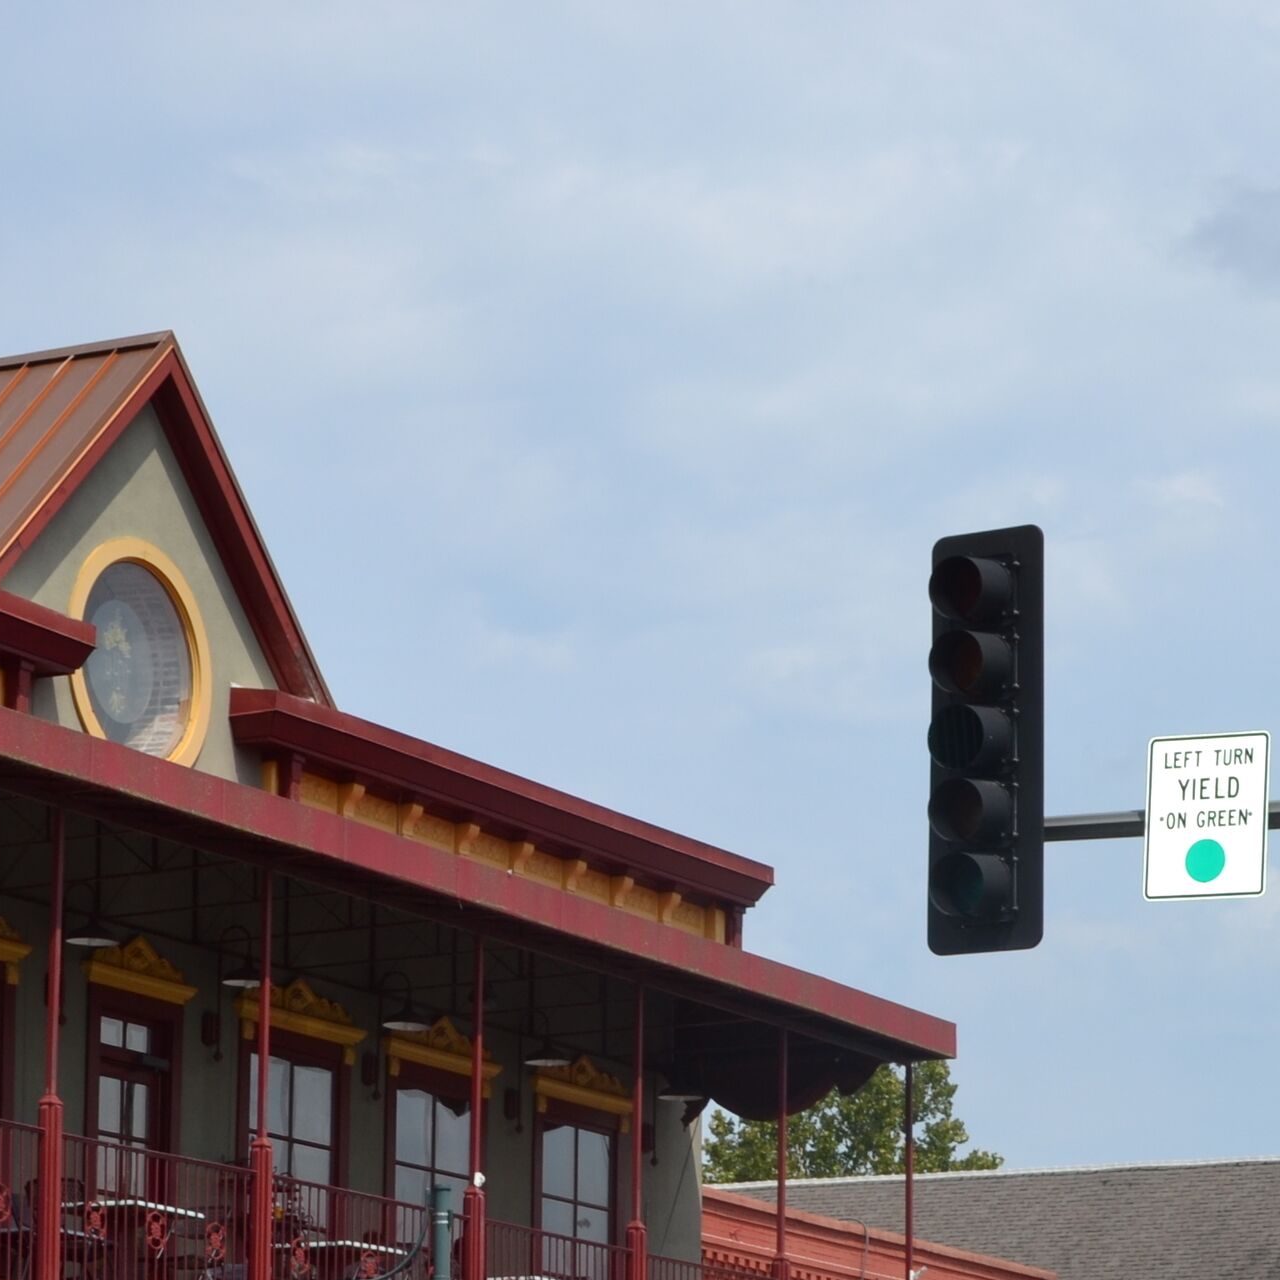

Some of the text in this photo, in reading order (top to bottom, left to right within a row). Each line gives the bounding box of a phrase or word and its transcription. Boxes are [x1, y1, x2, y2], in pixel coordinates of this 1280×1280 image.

[1164, 748, 1254, 769] LEFT TURN
[1178, 776, 1240, 801] YIELD
[1166, 808, 1249, 830] ON GREEN
